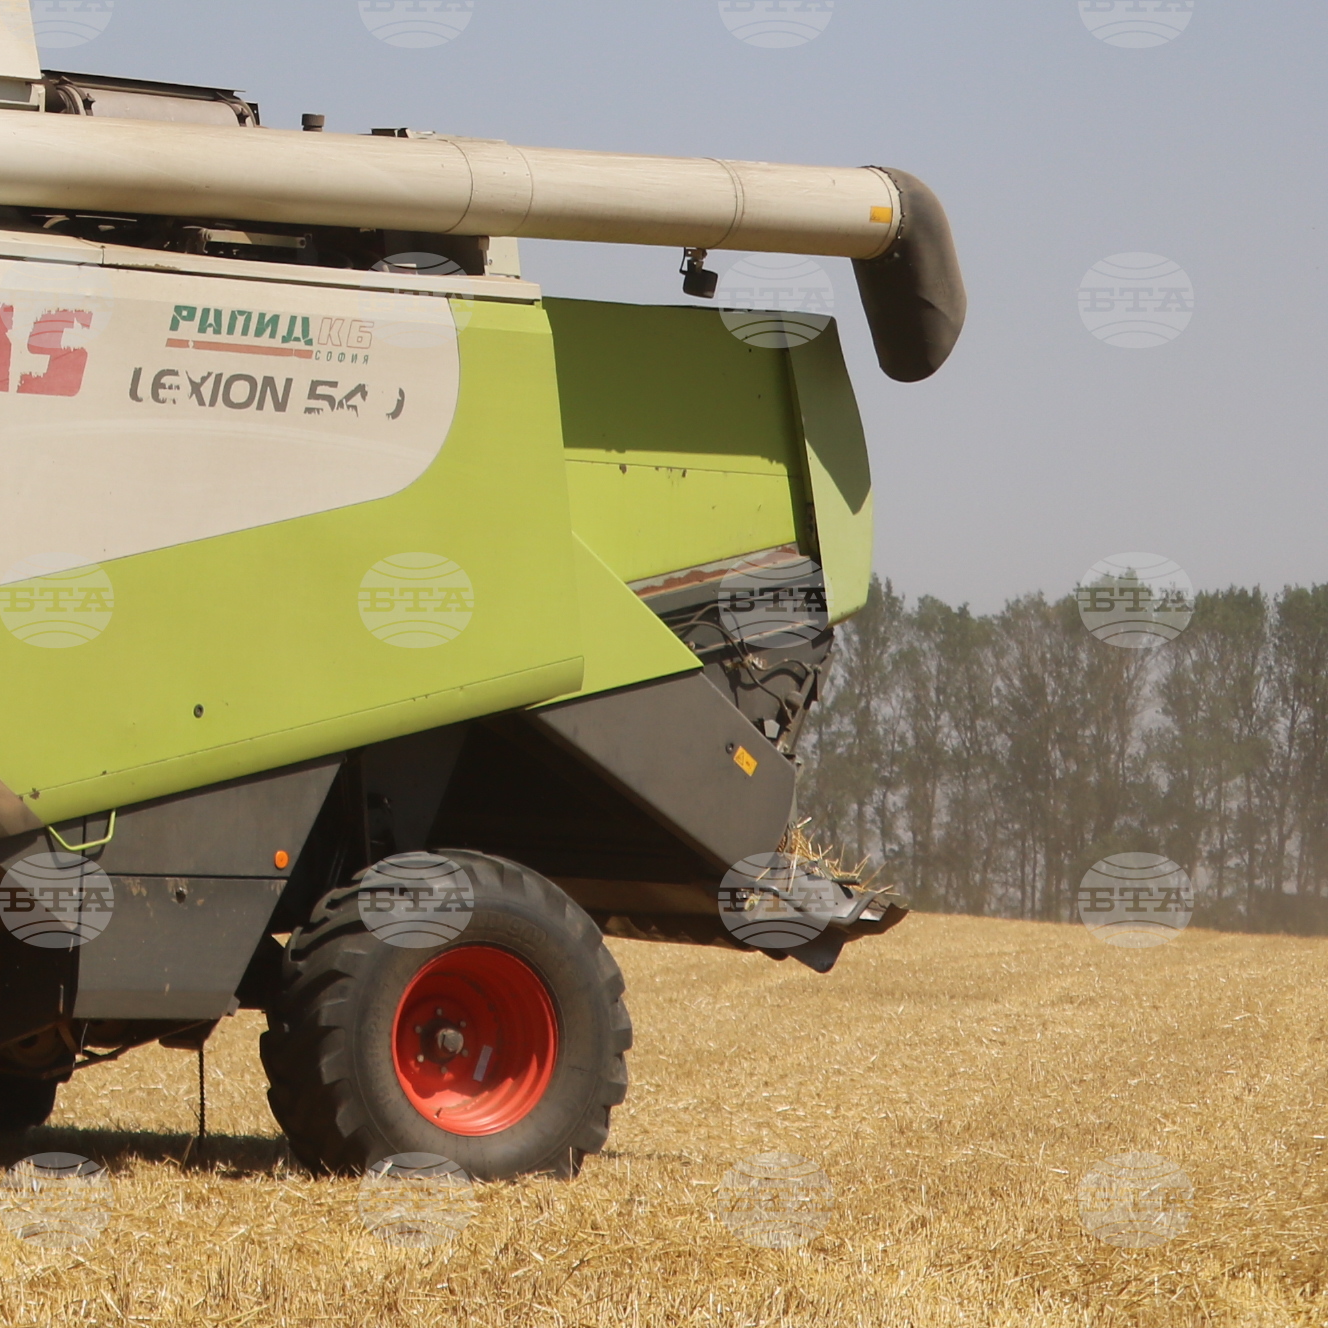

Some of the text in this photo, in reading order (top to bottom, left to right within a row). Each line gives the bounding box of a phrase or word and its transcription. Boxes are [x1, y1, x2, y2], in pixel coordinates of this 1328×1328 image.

[168, 304, 375, 350] РАПИД КБ
[314, 349, 370, 366] СОФИЯ
[128, 366, 294, 413] LEXION
